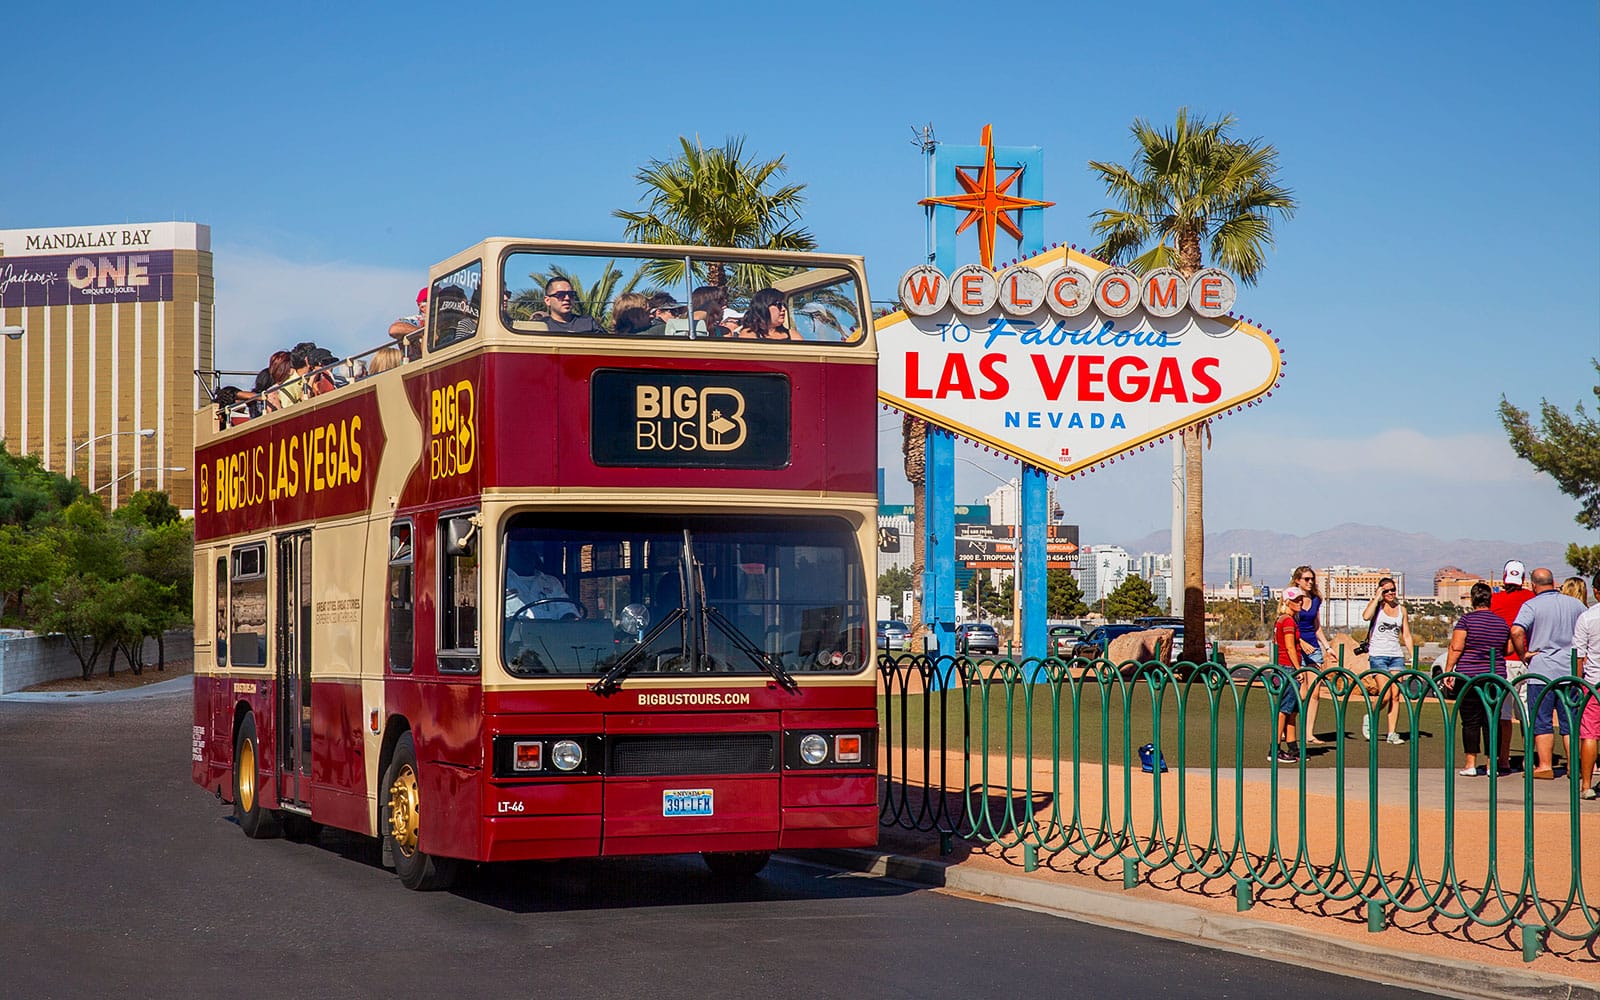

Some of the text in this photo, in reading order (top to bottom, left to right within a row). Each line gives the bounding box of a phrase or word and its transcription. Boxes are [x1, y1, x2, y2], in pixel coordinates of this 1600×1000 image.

[26, 230, 151, 250] MANDALAY BAY
[67, 255, 150, 289] ONE
[82, 288, 104, 296] CIRQUE
[114, 286, 137, 294] SOLEIL
[909, 275, 1223, 309] WELCOME
[936, 317, 1181, 349] TO Fabulous
[905, 351, 1223, 404] LAS VEGAS
[432, 385, 456, 436] BIG
[636, 385, 697, 419] BIG
[636, 421, 697, 451] BUS
[1004, 412, 1127, 429] NEVADA
[269, 435, 299, 501] LAS
[303, 415, 362, 493] VEGAS
[432, 435, 457, 480] BUS
[638, 693, 750, 706] BIGBUSTOURS.COM
[497, 801, 525, 813] LT-46
